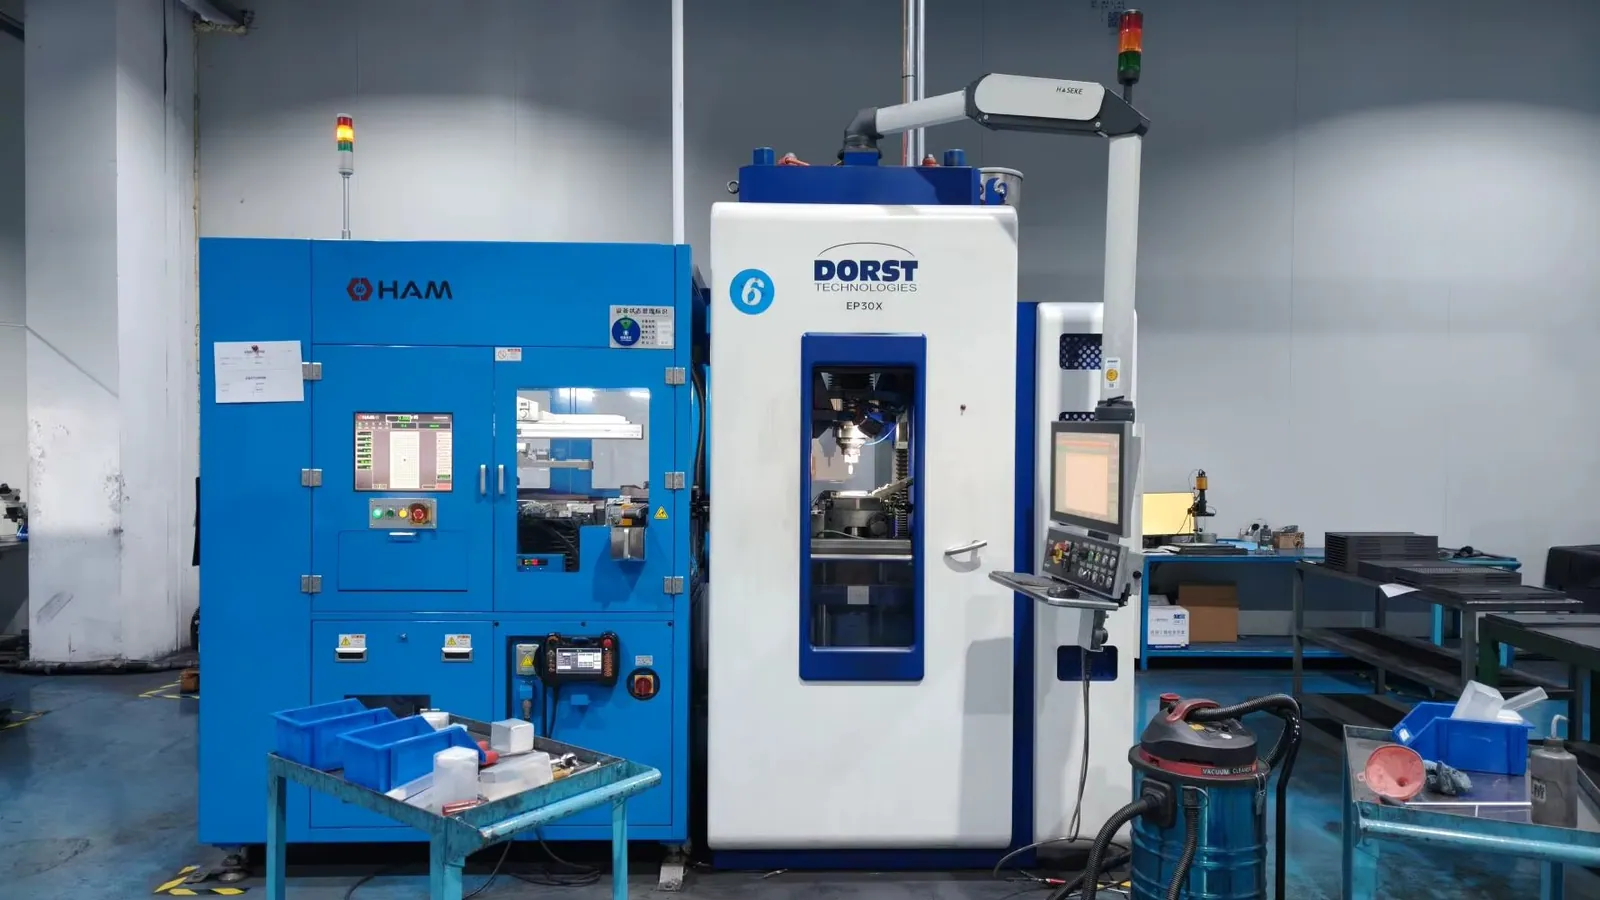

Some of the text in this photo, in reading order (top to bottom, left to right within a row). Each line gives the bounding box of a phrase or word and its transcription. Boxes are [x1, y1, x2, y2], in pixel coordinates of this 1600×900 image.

[814, 259, 918, 282] DORST
[378, 280, 452, 299] HAM
[741, 277, 765, 306] 6
[815, 283, 917, 292] TECHNOLOGIES
[846, 302, 883, 310] EP30X
